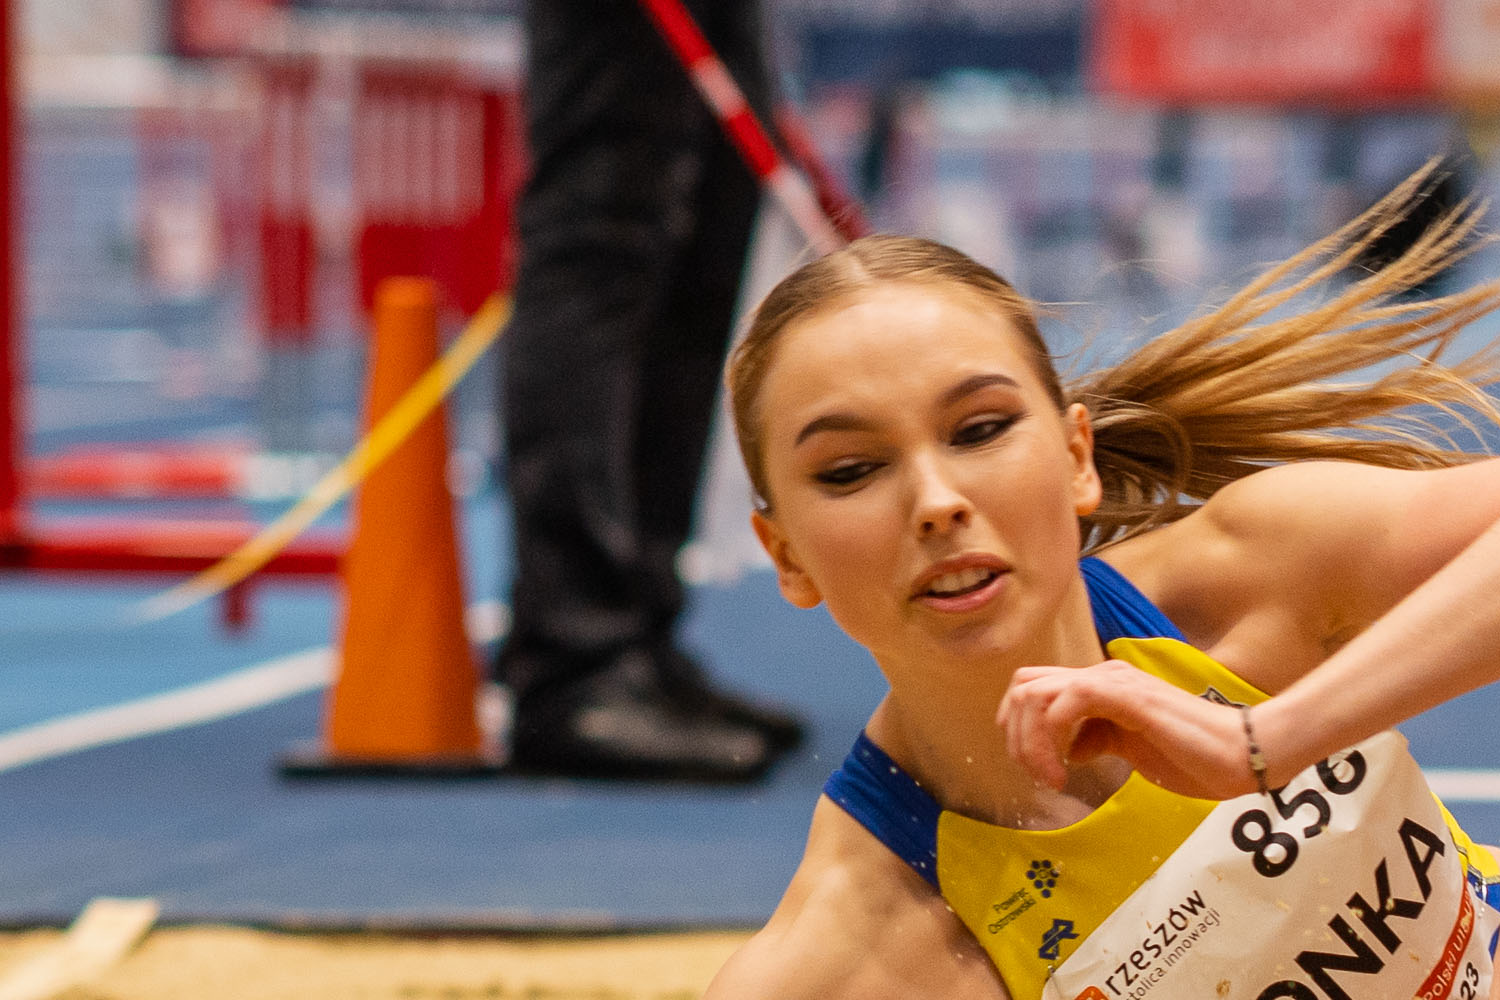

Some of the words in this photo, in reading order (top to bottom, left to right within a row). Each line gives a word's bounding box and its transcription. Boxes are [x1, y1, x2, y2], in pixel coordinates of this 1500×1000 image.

[1232, 750, 1367, 878] 856
[1105, 889, 1206, 996] rzeszów
[1162, 907, 1221, 968] innowacji
